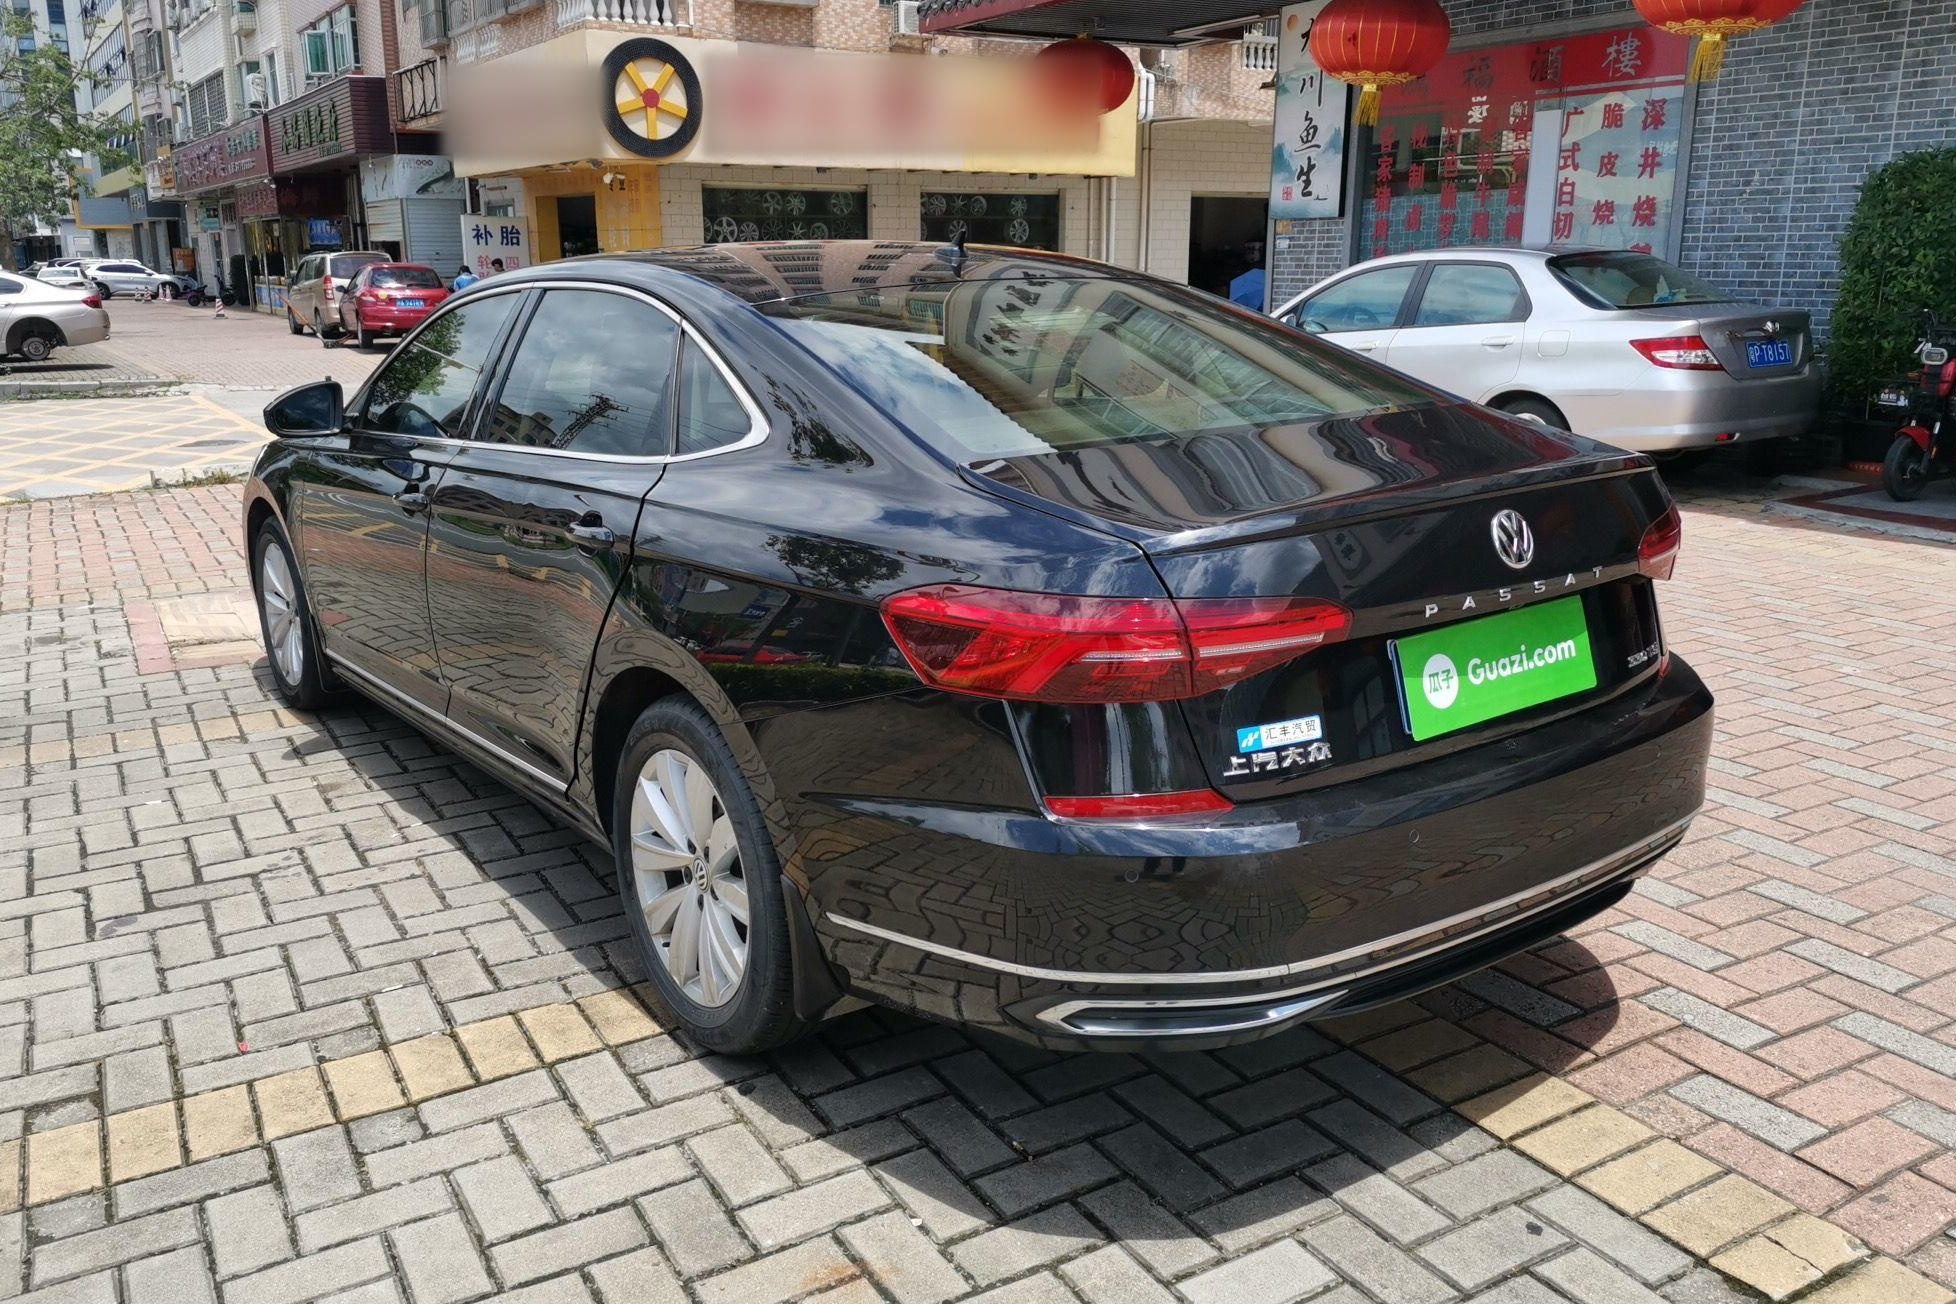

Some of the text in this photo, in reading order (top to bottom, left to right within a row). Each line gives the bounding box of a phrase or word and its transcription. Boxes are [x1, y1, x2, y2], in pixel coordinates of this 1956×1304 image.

[1552, 106, 1585, 241] 广式白切
[1592, 102, 1625, 226] 脆皮烧
[472, 223, 521, 247] 补胎
[1425, 566, 1603, 618] PASSAT
[1428, 668, 1454, 694] 瓜子
[1467, 639, 1577, 685] Guazi.com
[1265, 719, 1317, 740] 汇丰汽贸
[1223, 741, 1332, 777] 上汽大众
